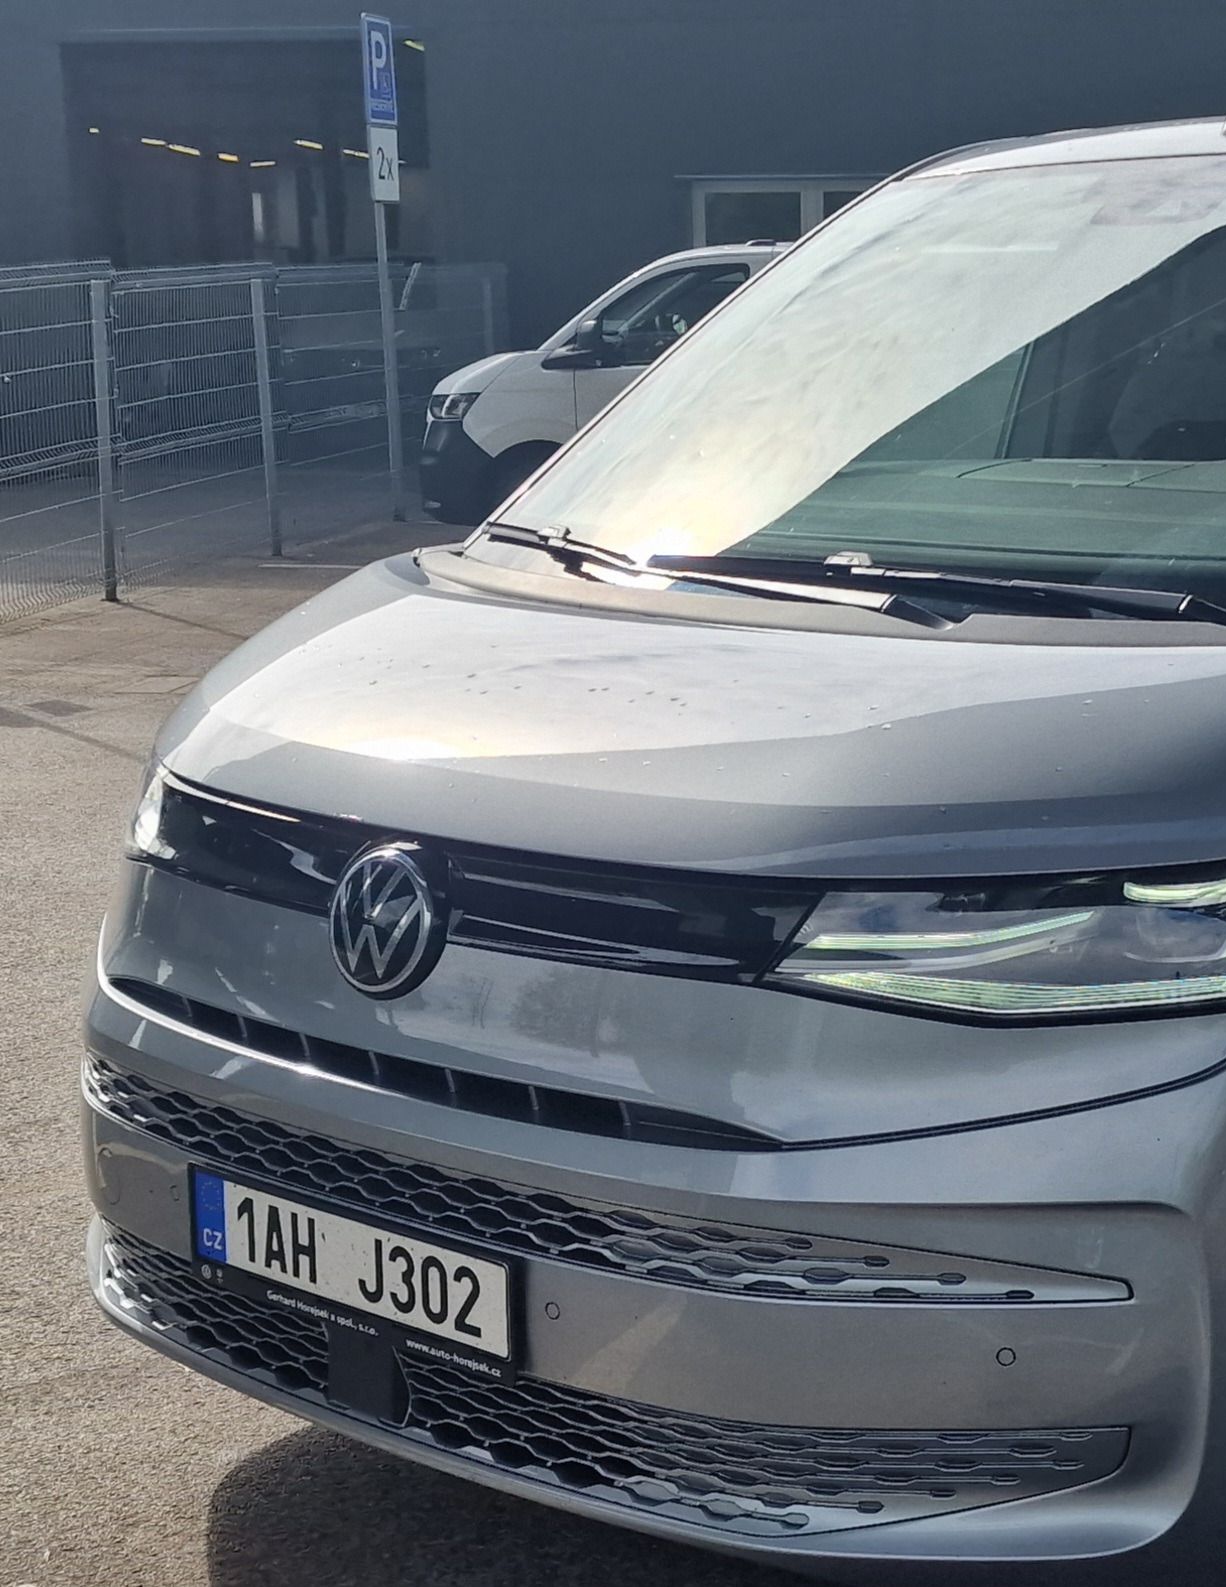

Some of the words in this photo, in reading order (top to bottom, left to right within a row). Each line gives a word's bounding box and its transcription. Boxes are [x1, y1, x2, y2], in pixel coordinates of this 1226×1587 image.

[370, 30, 387, 90] P
[376, 146, 394, 181] 2x
[338, 858, 424, 980] VW
[203, 1227, 224, 1250] CZ
[237, 1196, 318, 1285] 1AH
[358, 1238, 482, 1339] J302
